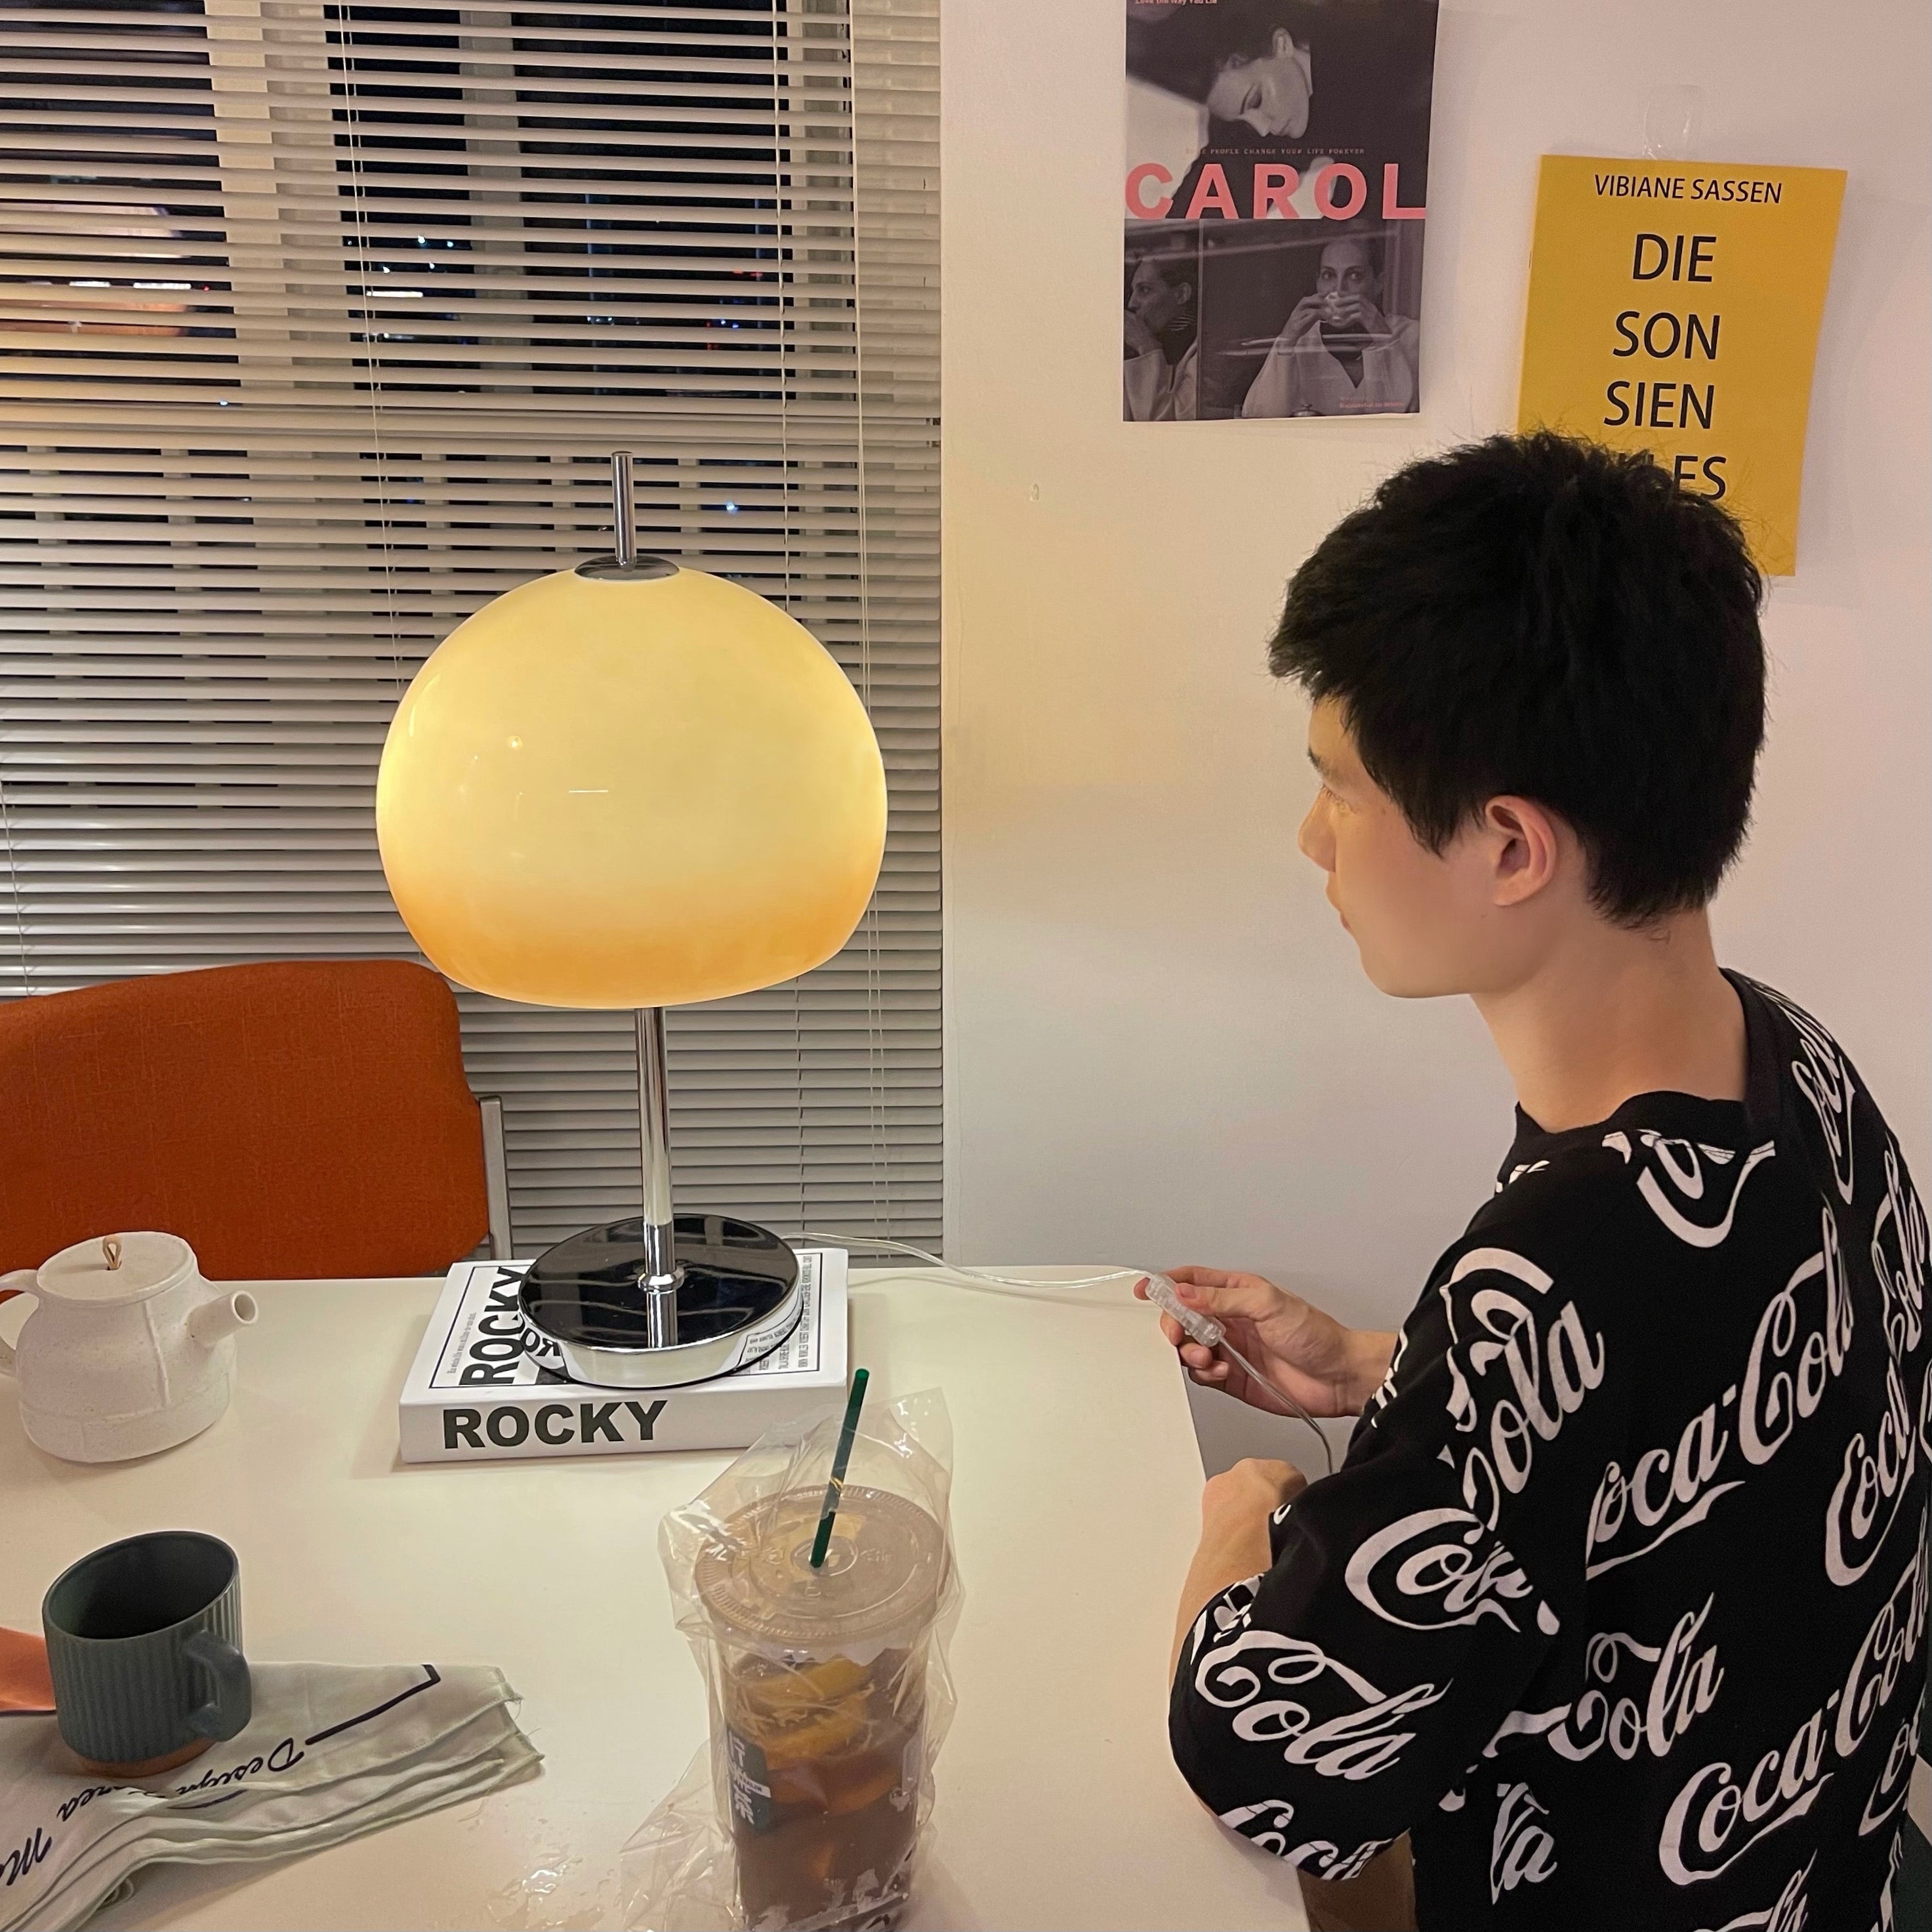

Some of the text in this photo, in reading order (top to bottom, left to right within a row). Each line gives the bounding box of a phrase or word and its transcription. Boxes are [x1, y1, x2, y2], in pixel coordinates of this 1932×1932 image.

[1124, 162, 1426, 220] CAROL
[1595, 174, 1782, 204] VIBIANE SASSEN
[1632, 233, 1717, 282] DIE
[1612, 310, 1720, 360] SON
[1603, 380, 1715, 430] SIEN
[459, 1265, 525, 1386] ROCKY
[443, 1400, 668, 1449] ROCKY
[1195, 1629, 1455, 1782] Cola
